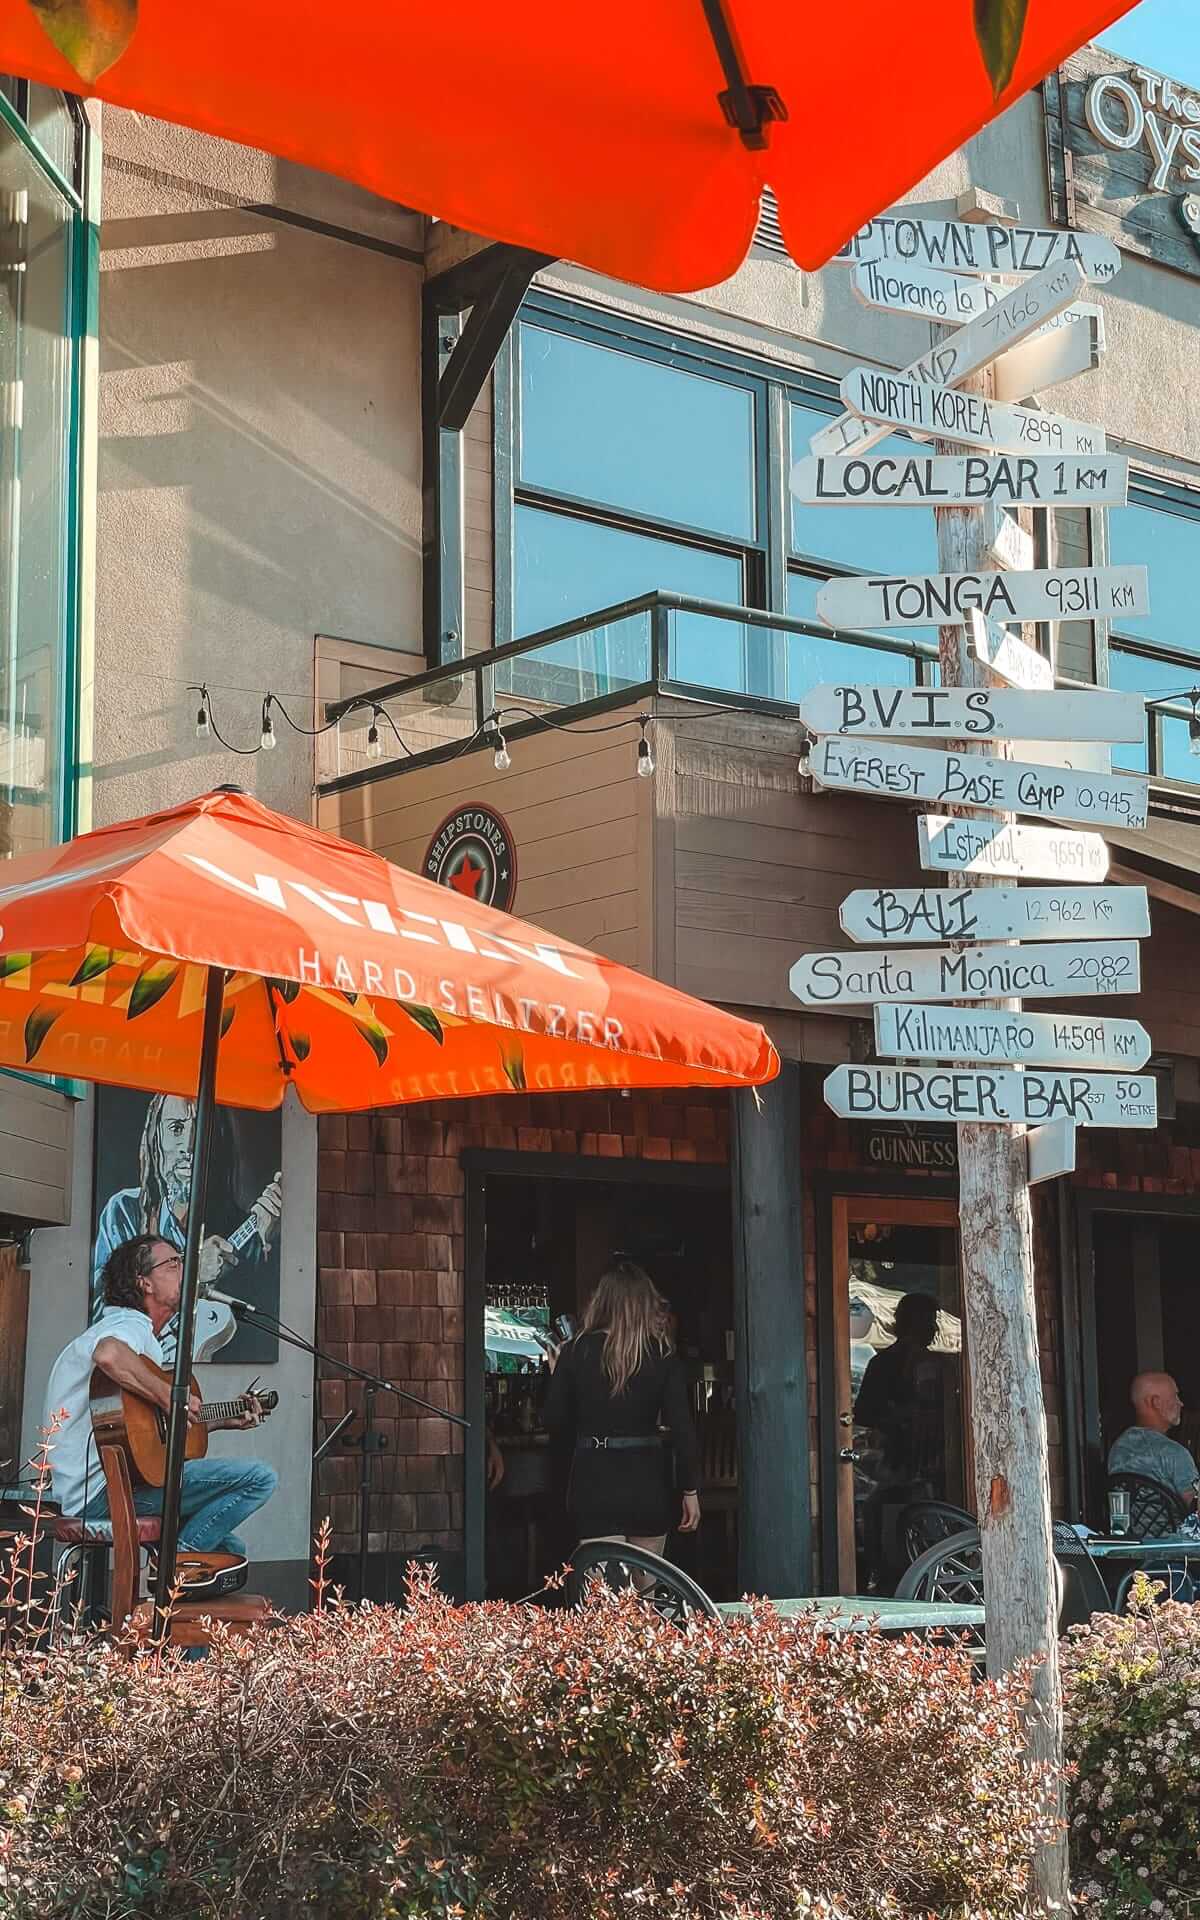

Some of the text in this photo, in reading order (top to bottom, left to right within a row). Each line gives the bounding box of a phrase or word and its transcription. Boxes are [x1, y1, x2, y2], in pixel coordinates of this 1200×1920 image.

[986, 226, 1087, 274] PIZZA
[1094, 263, 1115, 277] KM
[860, 258, 947, 316] Thorang
[955, 280, 977, 313] La
[860, 373, 923, 424] NORTH
[931, 389, 995, 440] KOREA
[1076, 435, 1093, 454] KM
[816, 458, 1108, 499] LOCAL BAR 1 KM
[868, 574, 1016, 621] TONGA
[1112, 586, 1135, 608] KM
[824, 741, 925, 796] EVEREST
[938, 757, 1005, 805] BASE
[1018, 772, 1065, 811] CAMP
[428, 813, 506, 872] SHIPSTONES
[1126, 813, 1145, 828] KM
[938, 823, 1019, 868] Istanbul
[865, 888, 978, 939] BALI
[298, 947, 416, 1000] HARD
[439, 978, 624, 1049] SELTZER
[806, 954, 1133, 1000] Santa Monica 2082
[1096, 977, 1118, 993] KM
[1113, 1033, 1138, 1056] KM
[847, 1069, 1141, 1121] BURGER BAR 50
[1119, 1103, 1157, 1116] METRE
[869, 1135, 956, 1168] GUINNESS
